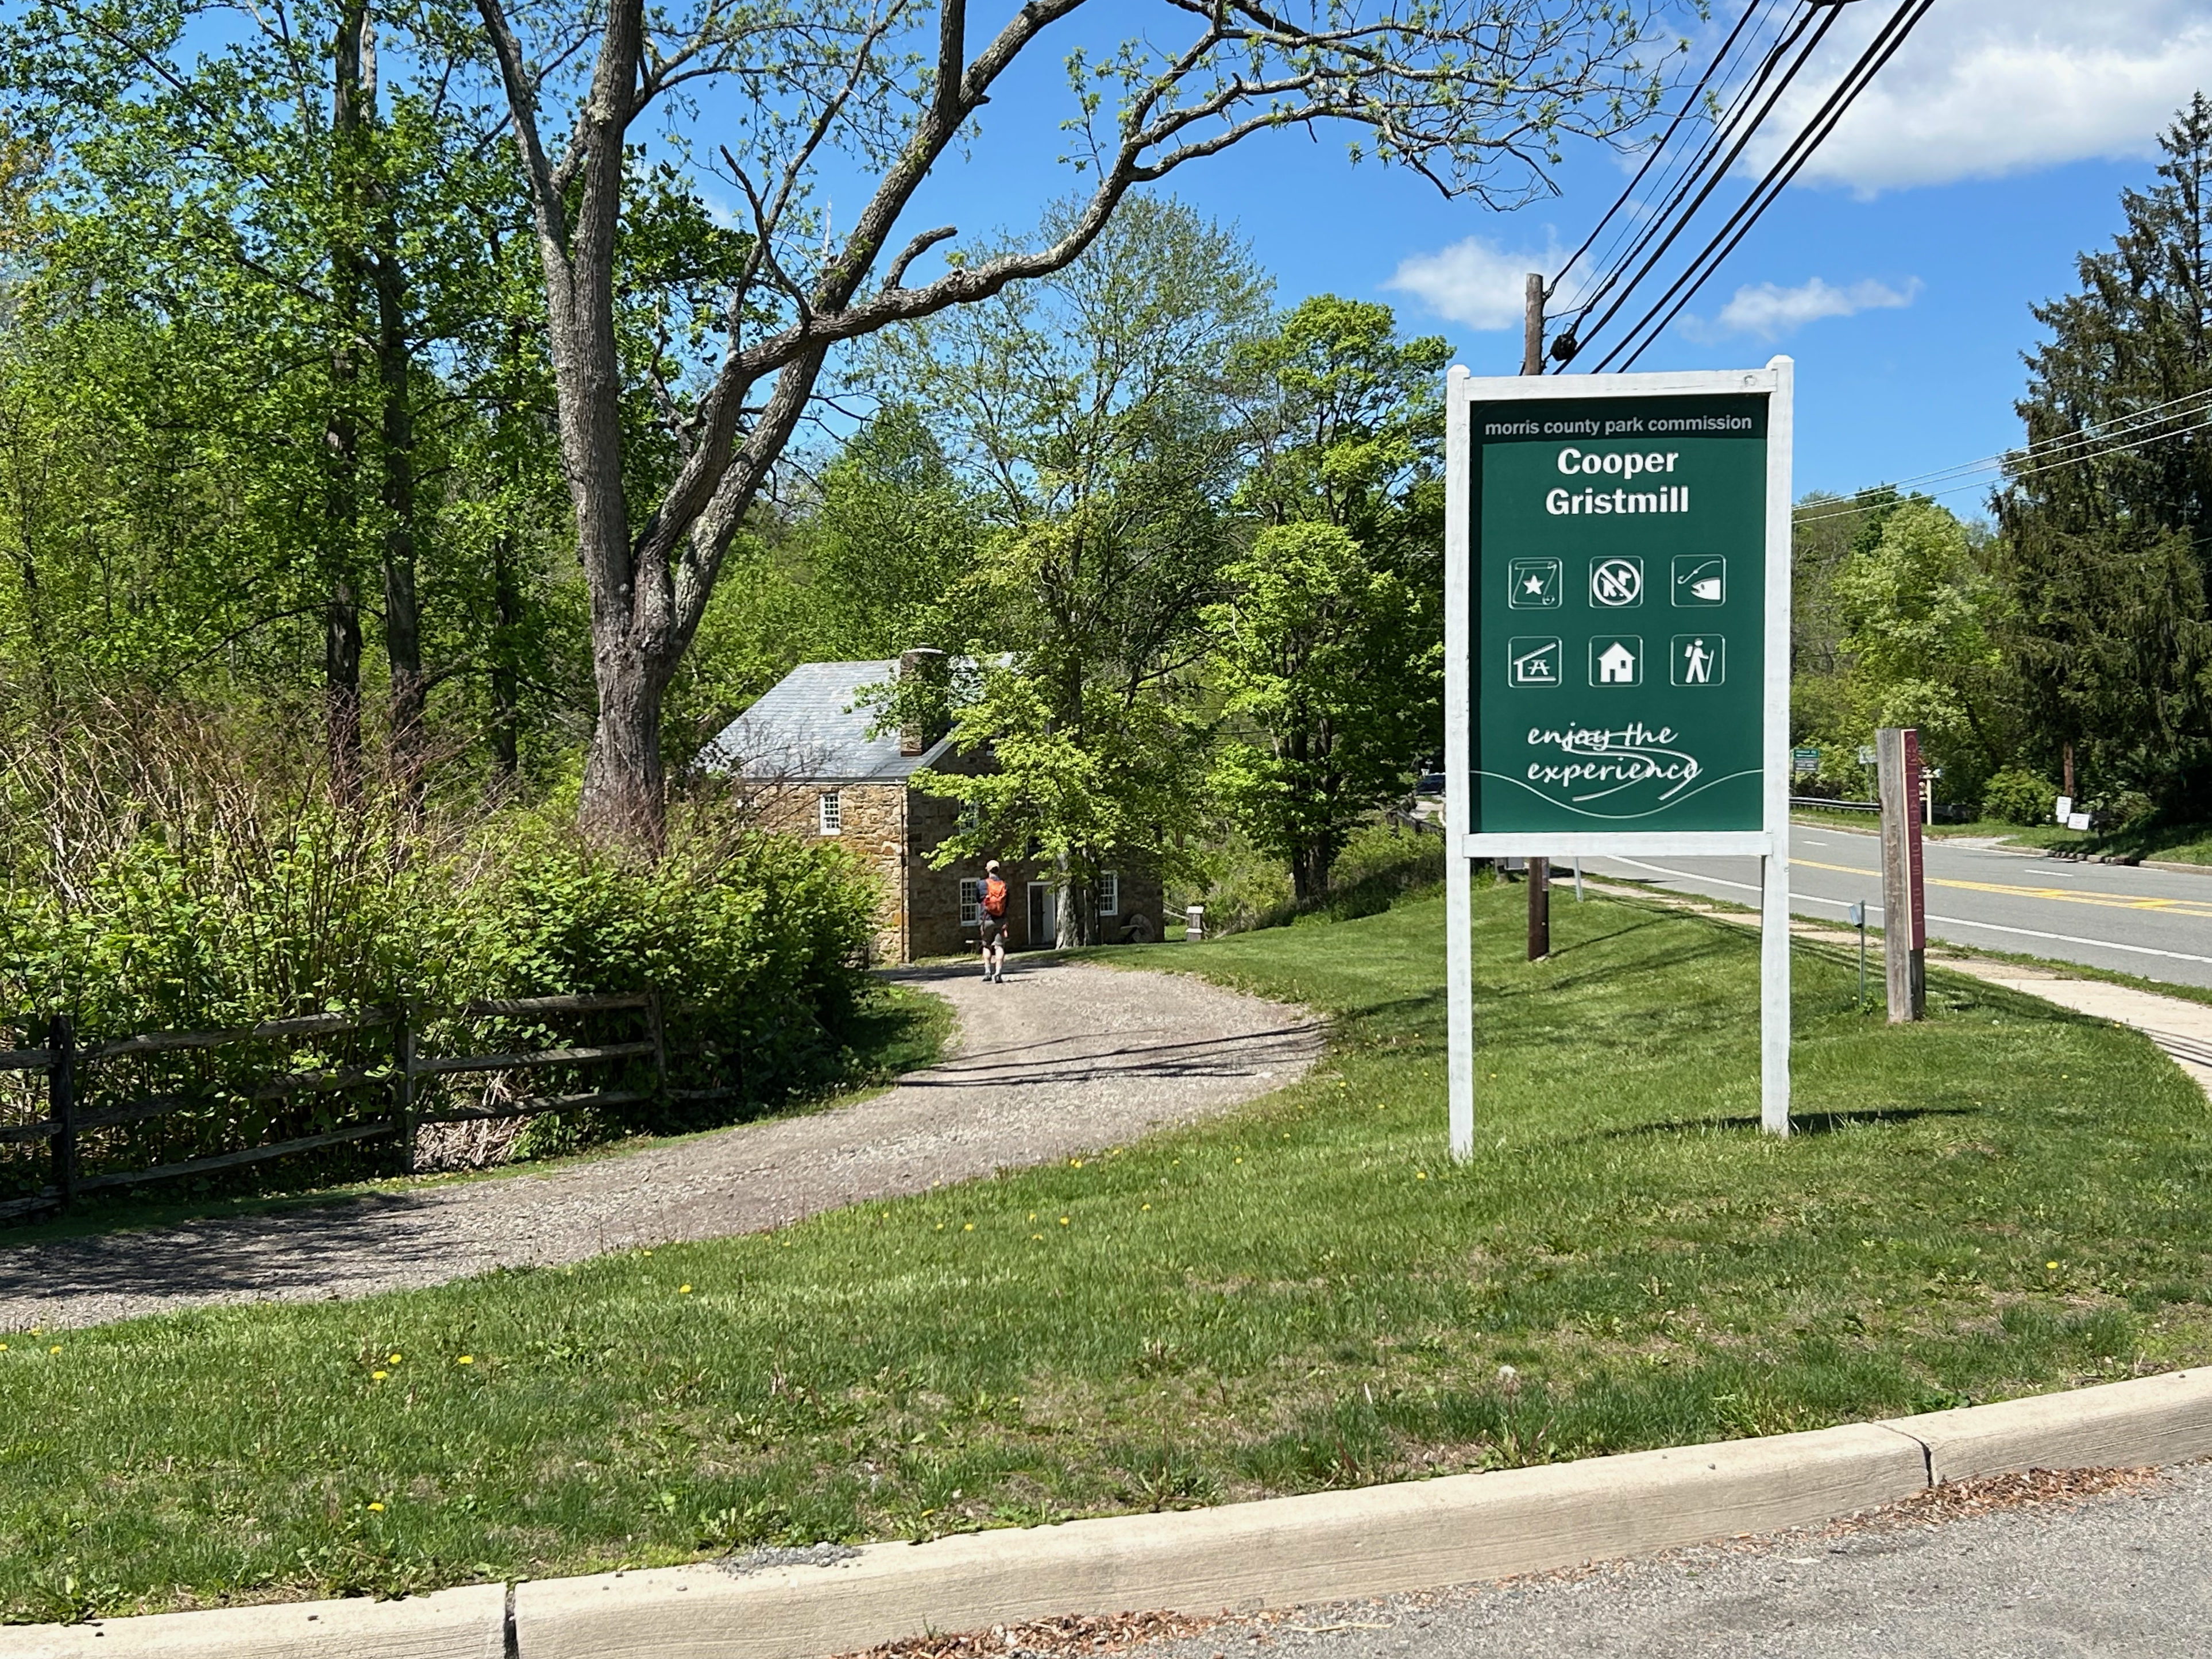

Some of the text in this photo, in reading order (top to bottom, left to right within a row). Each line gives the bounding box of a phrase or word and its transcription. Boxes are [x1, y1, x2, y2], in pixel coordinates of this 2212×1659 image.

[1485, 415, 1752, 435] morris county park commission
[1557, 447, 1679, 480] Cooper
[1546, 485, 1689, 515] Gristmill
[1528, 722, 1678, 751] enjoy the
[1528, 757, 1703, 787] experience
